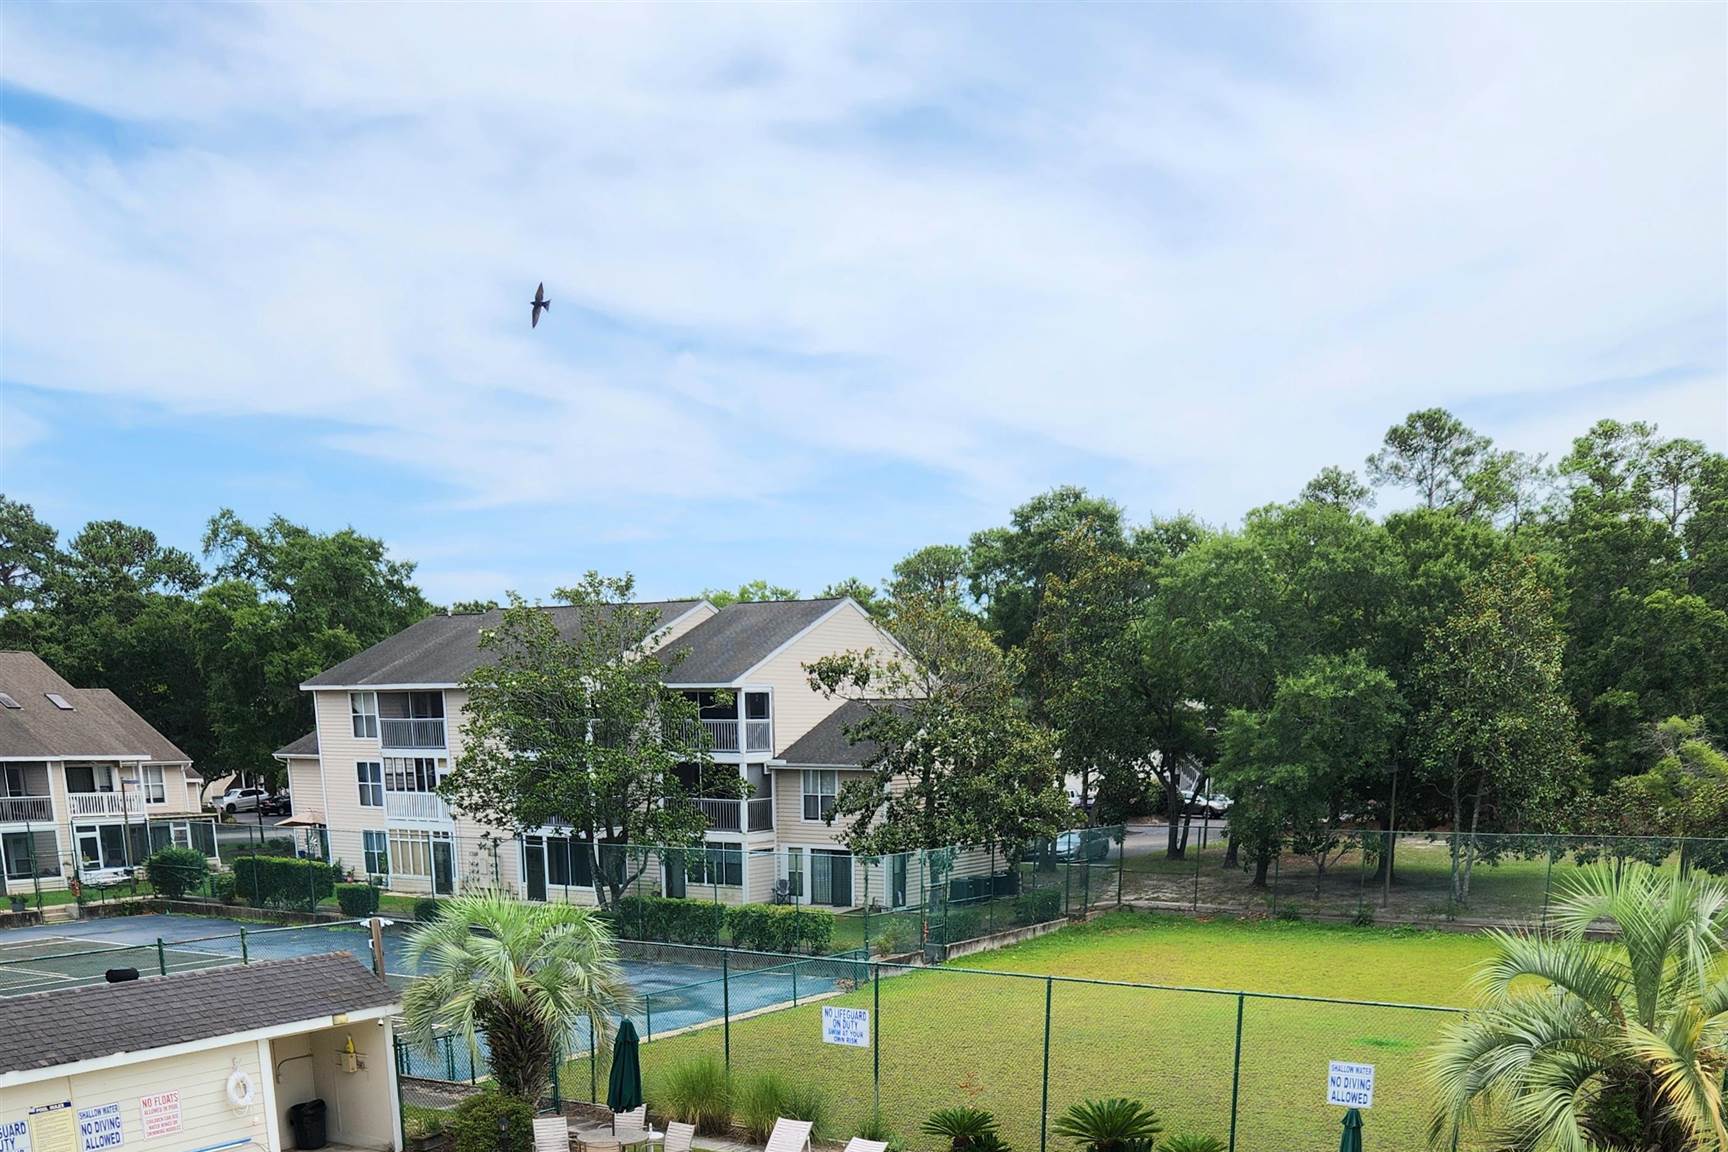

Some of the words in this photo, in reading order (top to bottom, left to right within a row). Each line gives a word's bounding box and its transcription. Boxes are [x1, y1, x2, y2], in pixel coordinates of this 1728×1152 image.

[825, 1007, 833, 1018] NO
[834, 1008, 867, 1021] LIFEGUARD
[833, 1018, 841, 1029] ON
[843, 1019, 858, 1030] DUTY
[1330, 1076, 1341, 1088] NO
[1344, 1076, 1371, 1091] DIVING
[142, 1098, 153, 1109] NO
[154, 1092, 179, 1107] FLOATS
[1331, 1090, 1368, 1105] ALLOWED
[81, 1122, 92, 1137] NO
[94, 1116, 120, 1134] DIVING
[86, 1131, 120, 1151] ALLOWED
